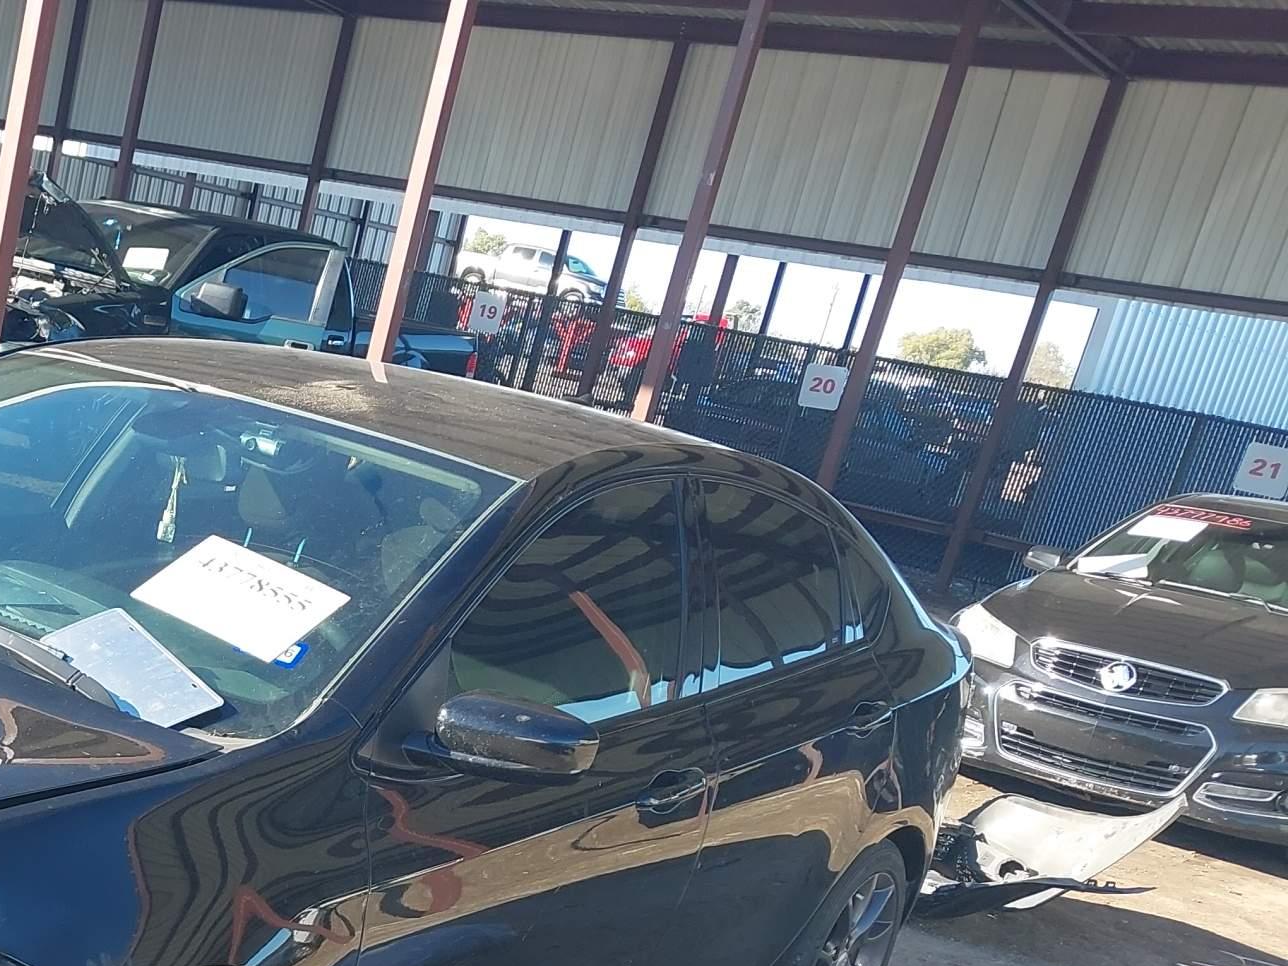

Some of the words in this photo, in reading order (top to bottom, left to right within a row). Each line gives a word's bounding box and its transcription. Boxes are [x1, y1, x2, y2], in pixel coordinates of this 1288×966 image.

[479, 303, 498, 320] 19
[809, 376, 836, 394] 20
[1248, 458, 1282, 480] 21
[197, 557, 312, 612] 43778555
